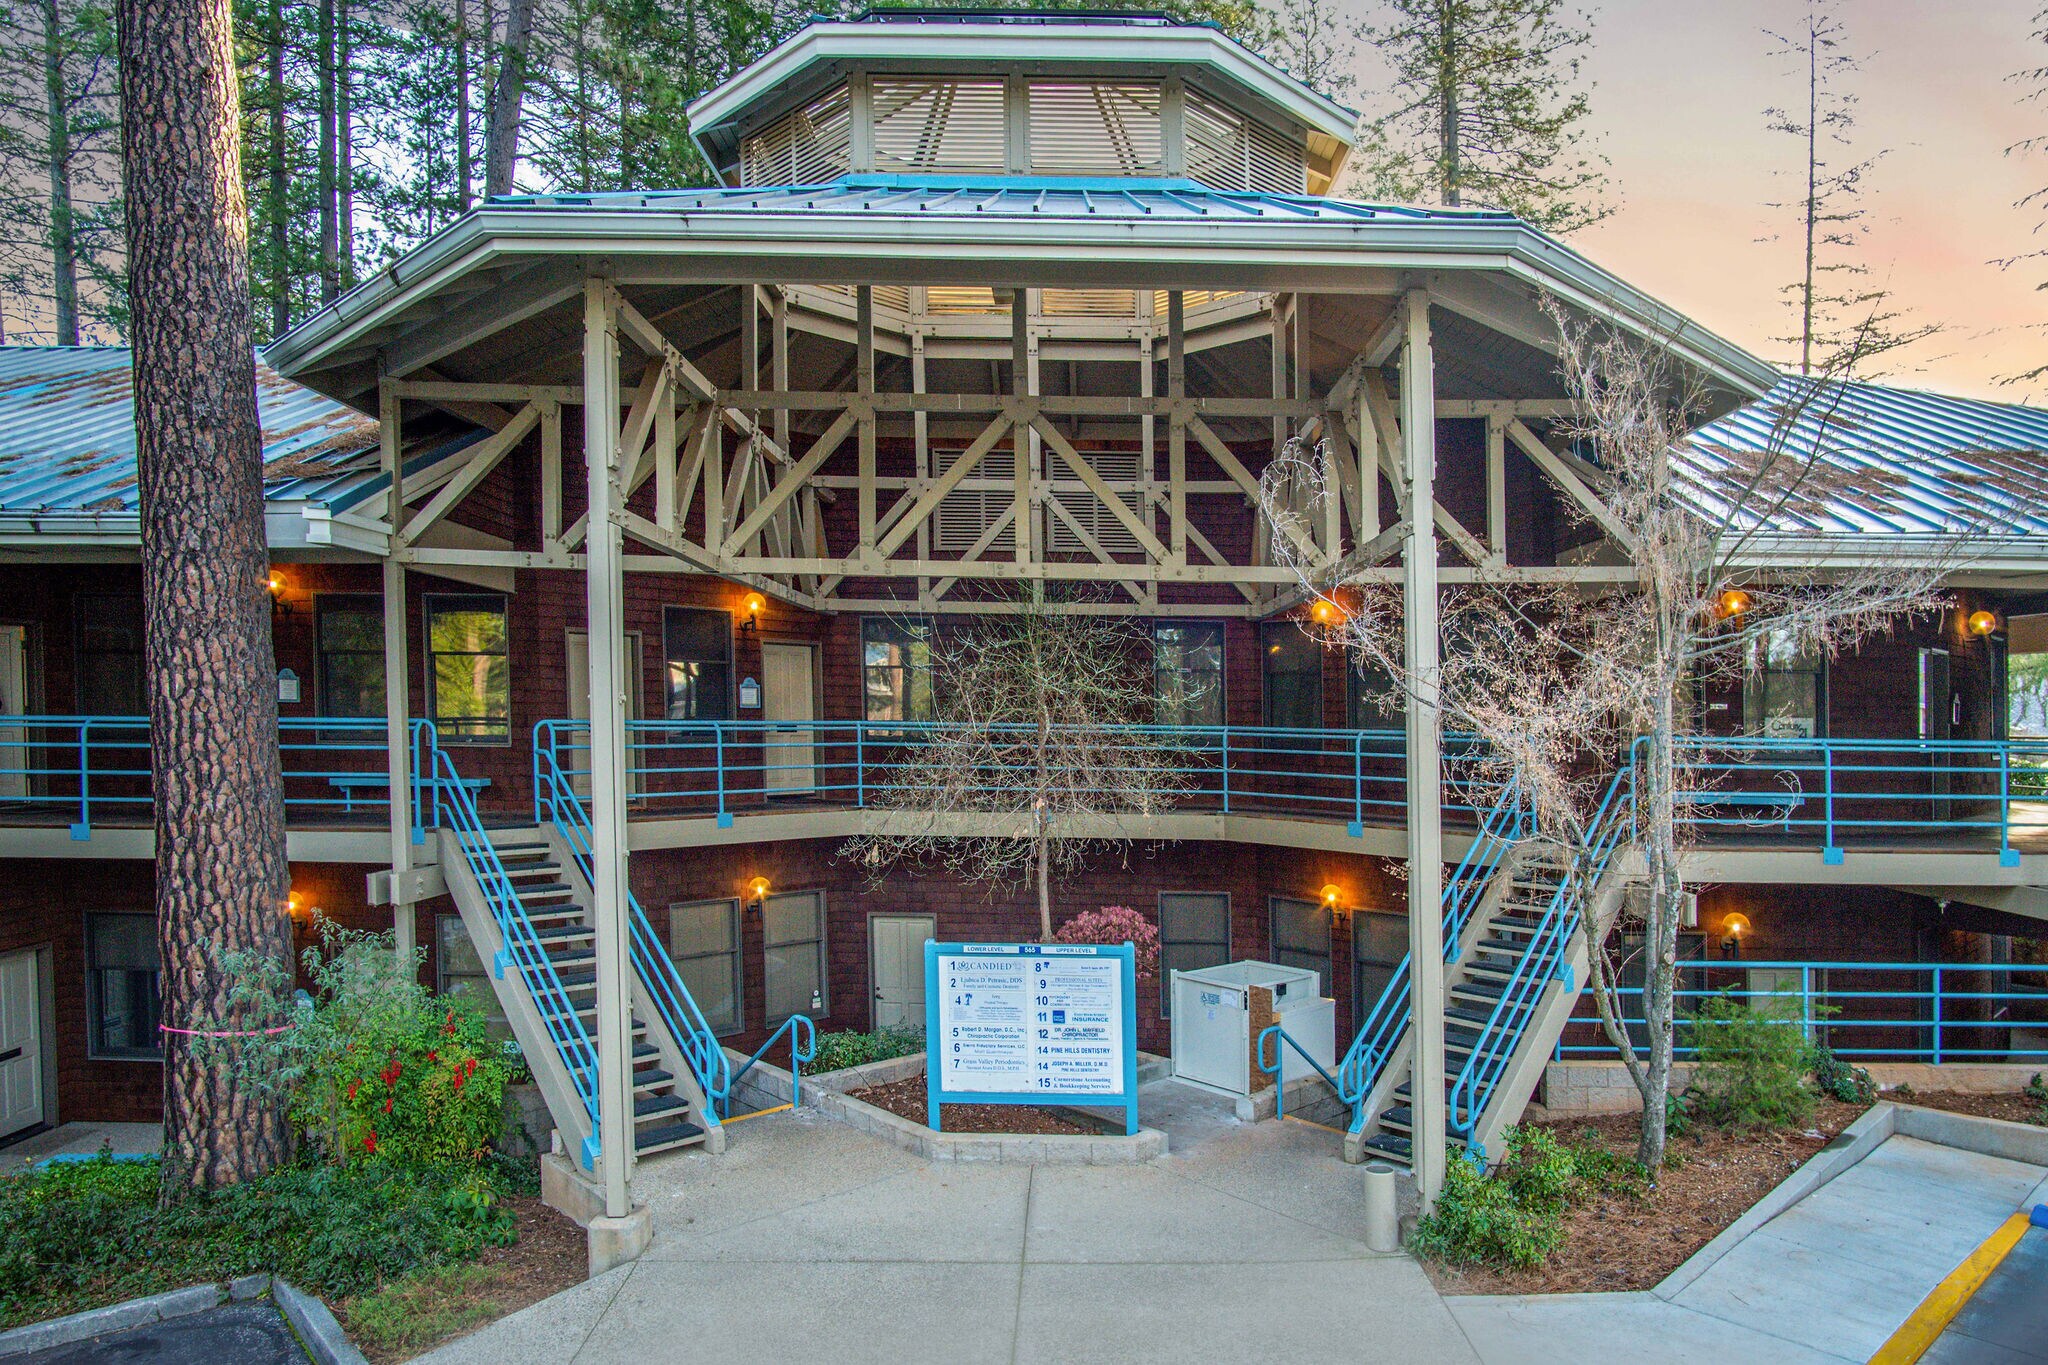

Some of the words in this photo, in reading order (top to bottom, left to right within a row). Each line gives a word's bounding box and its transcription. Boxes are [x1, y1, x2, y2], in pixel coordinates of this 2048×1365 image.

[1798, 727, 1807, 738] 21
[950, 961, 955, 971] 1
[970, 962, 1012, 970] CANDIED
[1035, 962, 1042, 973] 8
[950, 978, 957, 988] 2
[1040, 979, 1047, 989] 9
[955, 995, 962, 1005] 4
[1035, 995, 1048, 1006] 10
[1037, 1012, 1047, 1022] 11
[952, 1027, 959, 1037] 5
[1037, 1029, 1049, 1039] 12
[954, 1042, 961, 1053] 6
[1037, 1046, 1049, 1054] 14
[953, 1059, 960, 1069] 7
[1037, 1062, 1049, 1071] 14
[1038, 1077, 1051, 1088] 15
